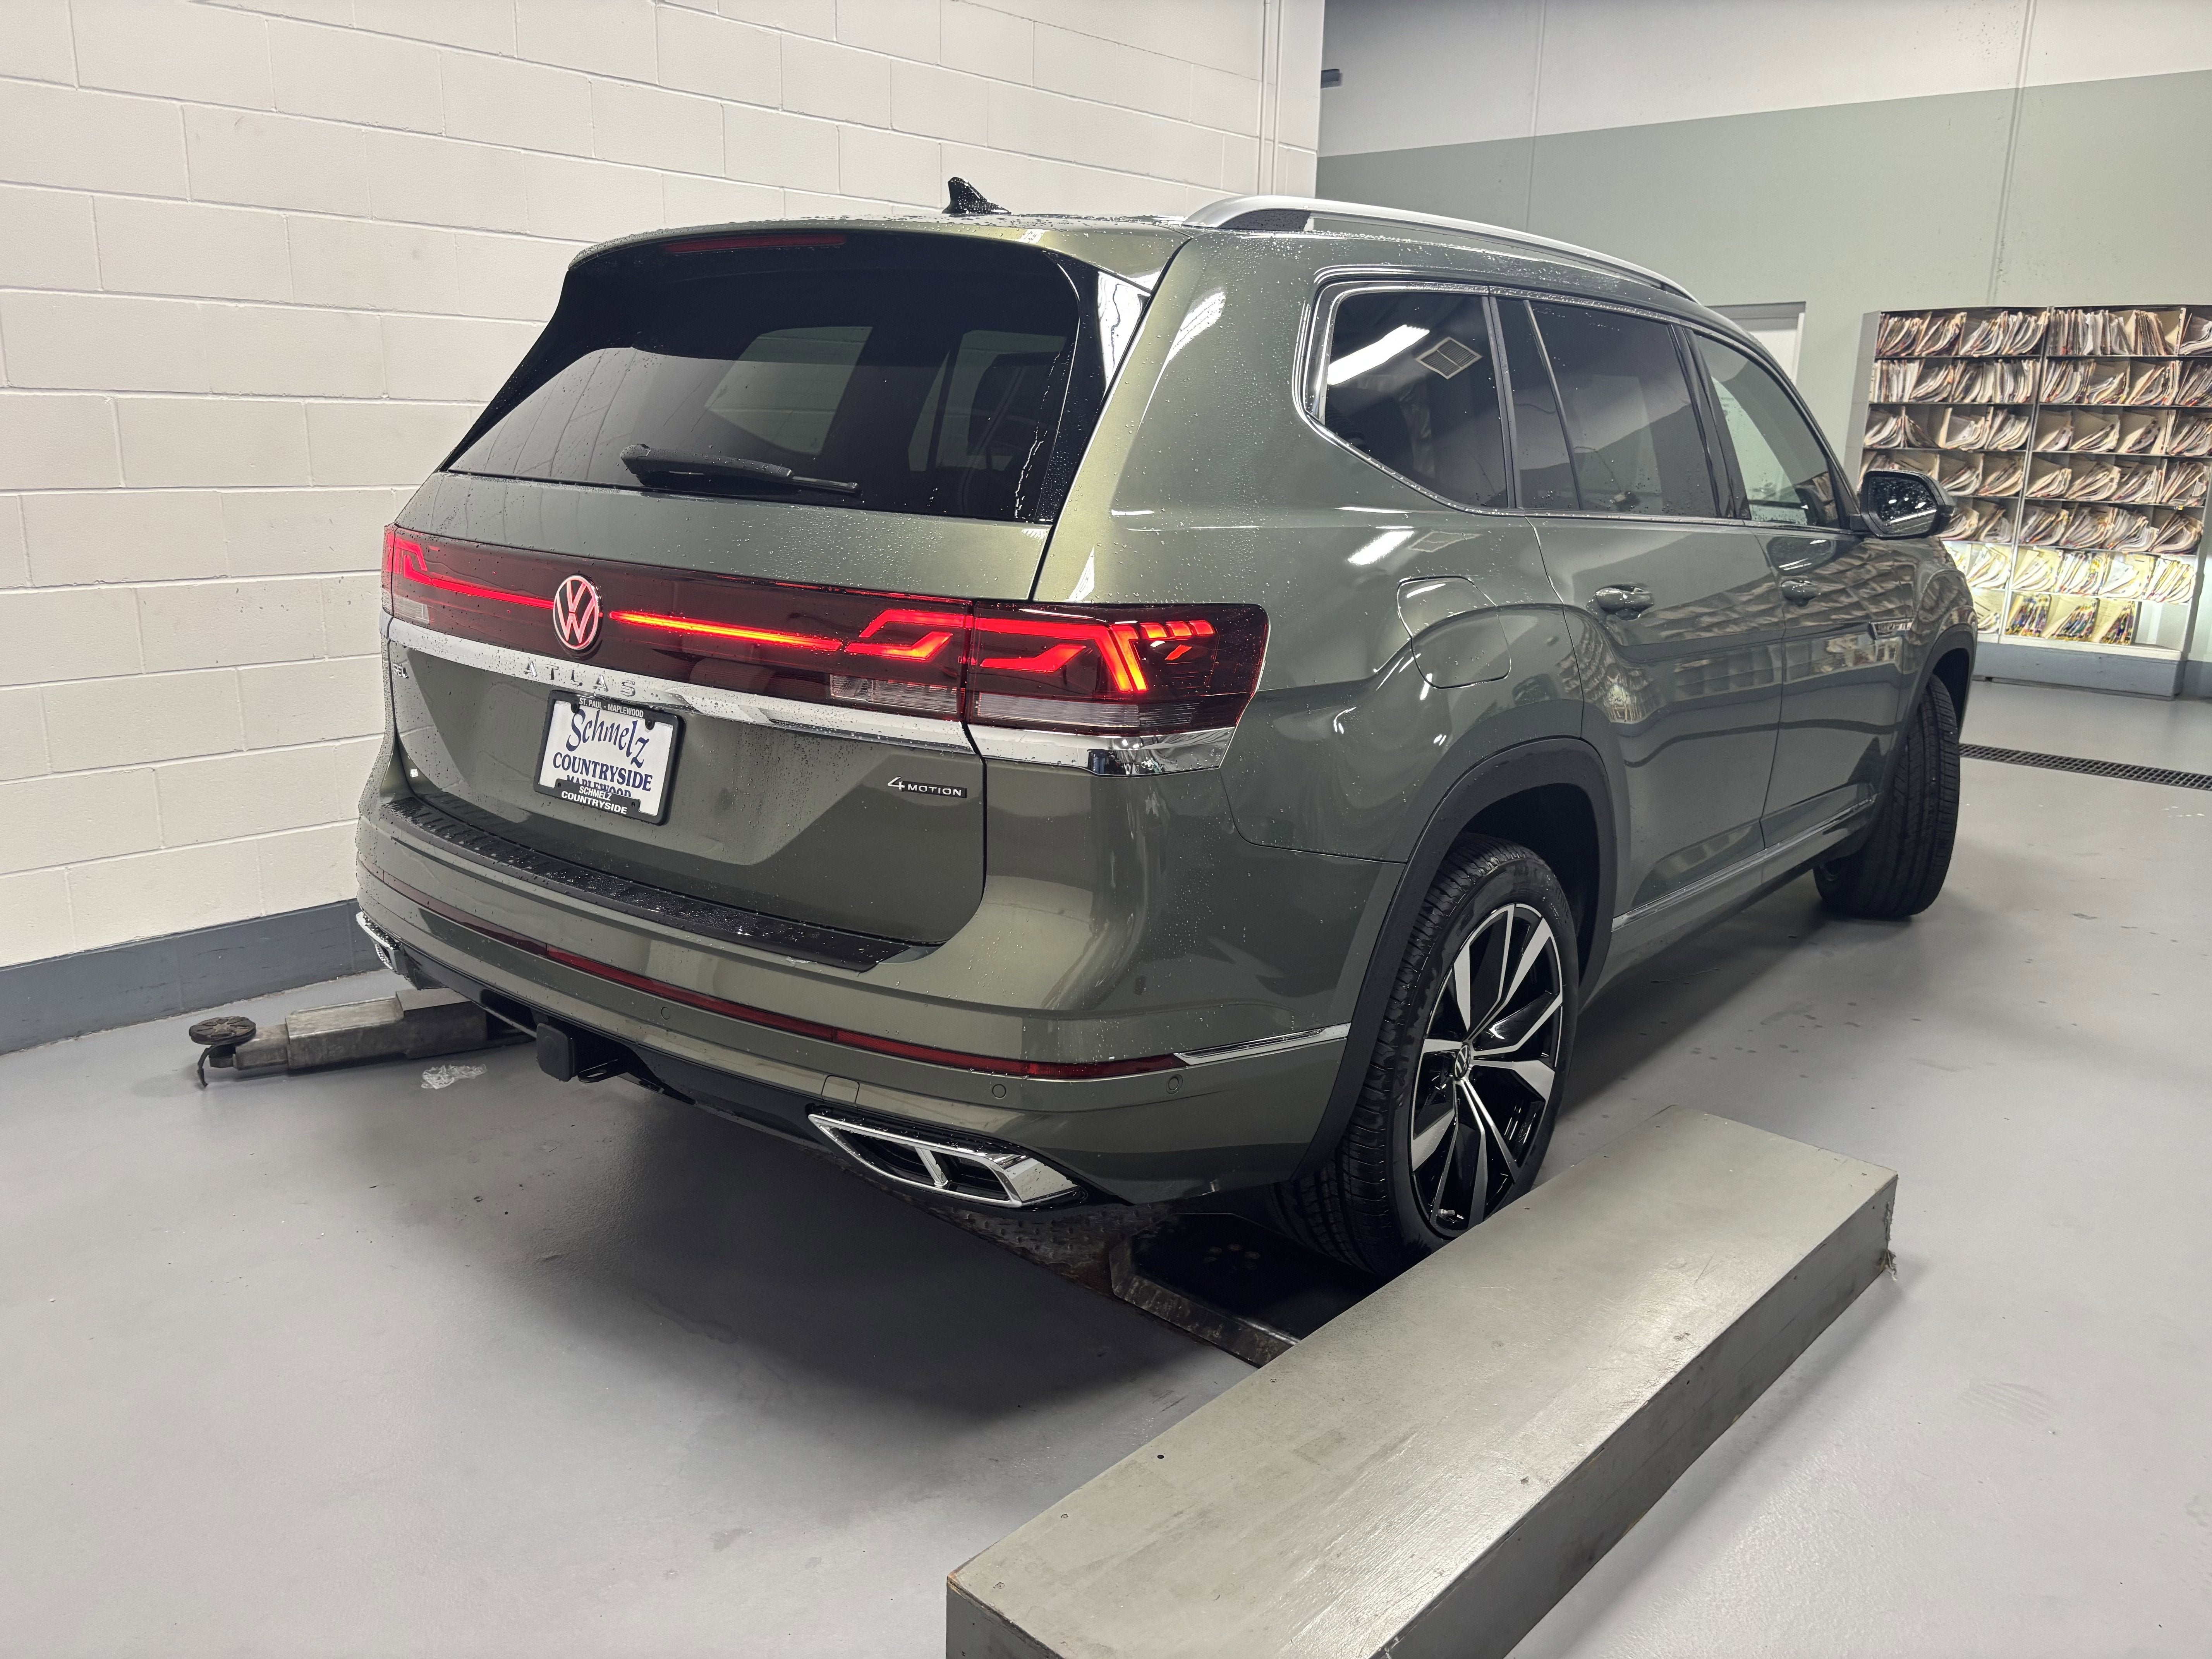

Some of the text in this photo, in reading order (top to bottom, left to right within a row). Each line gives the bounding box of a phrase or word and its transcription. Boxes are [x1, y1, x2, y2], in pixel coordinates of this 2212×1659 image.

[523, 660, 636, 697] ATLAS
[579, 697, 587, 706] ST.
[589, 699, 603, 709] PAUL
[608, 704, 644, 718] MAPLEWOOD
[566, 709, 649, 768] Schmelz
[553, 752, 653, 792] COUNTRYSIDE
[579, 786, 612, 801] SCHMELZ
[887, 776, 962, 796] 4MOTION
[562, 791, 628, 814] COUNTRYSIDE
